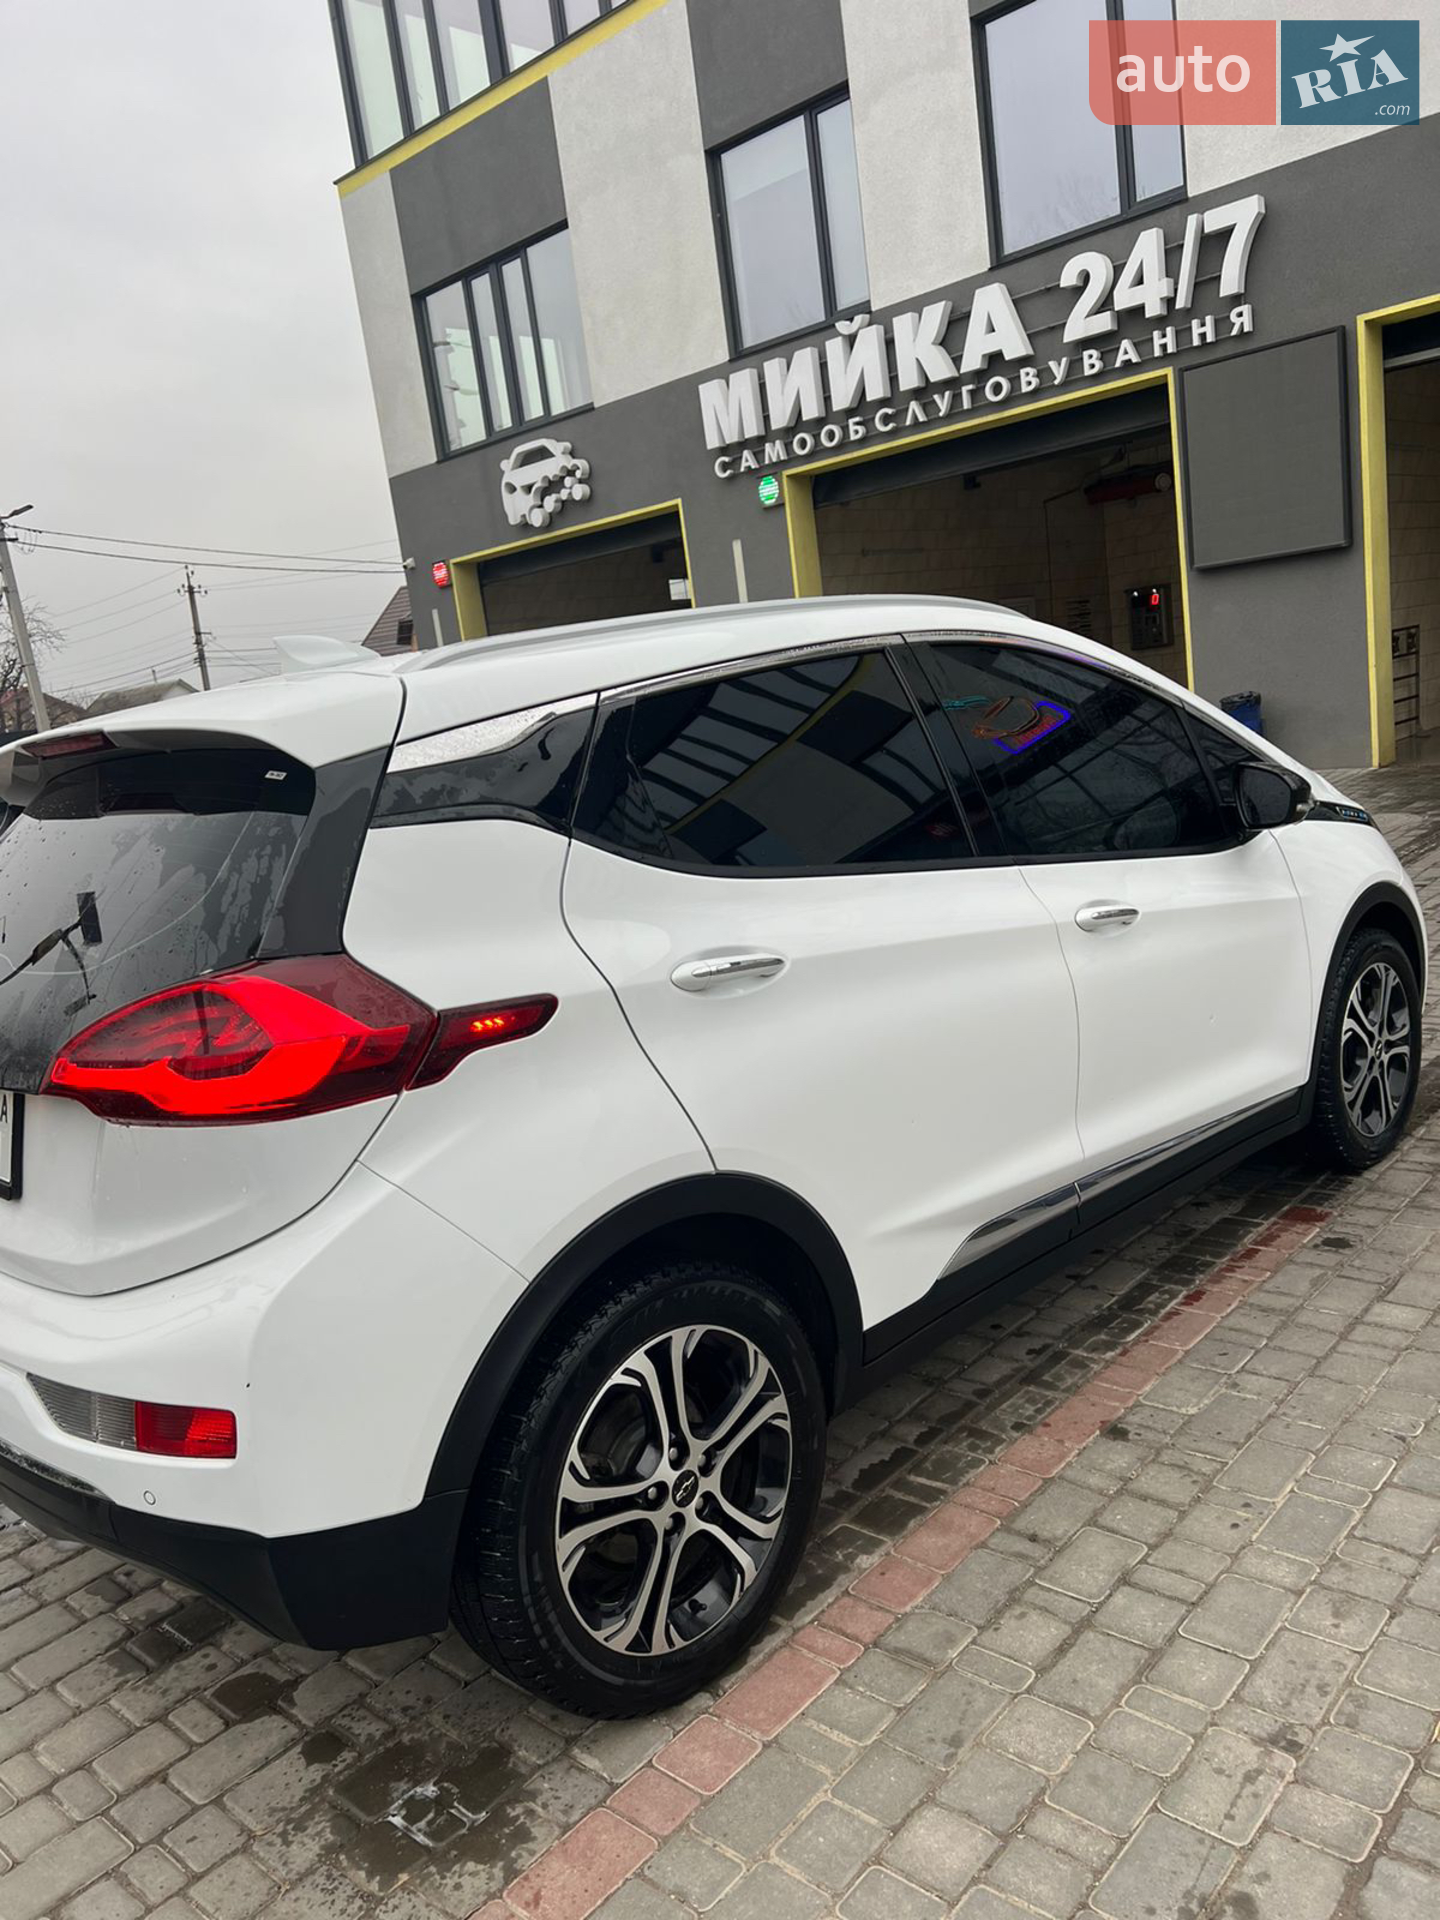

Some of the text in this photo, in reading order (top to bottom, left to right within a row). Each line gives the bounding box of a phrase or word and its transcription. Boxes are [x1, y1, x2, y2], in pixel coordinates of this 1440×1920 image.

[698, 194, 1266, 450] МИЙКА 24/7
[713, 304, 1254, 479] САМООБСЛУГОВУВАННЯ
